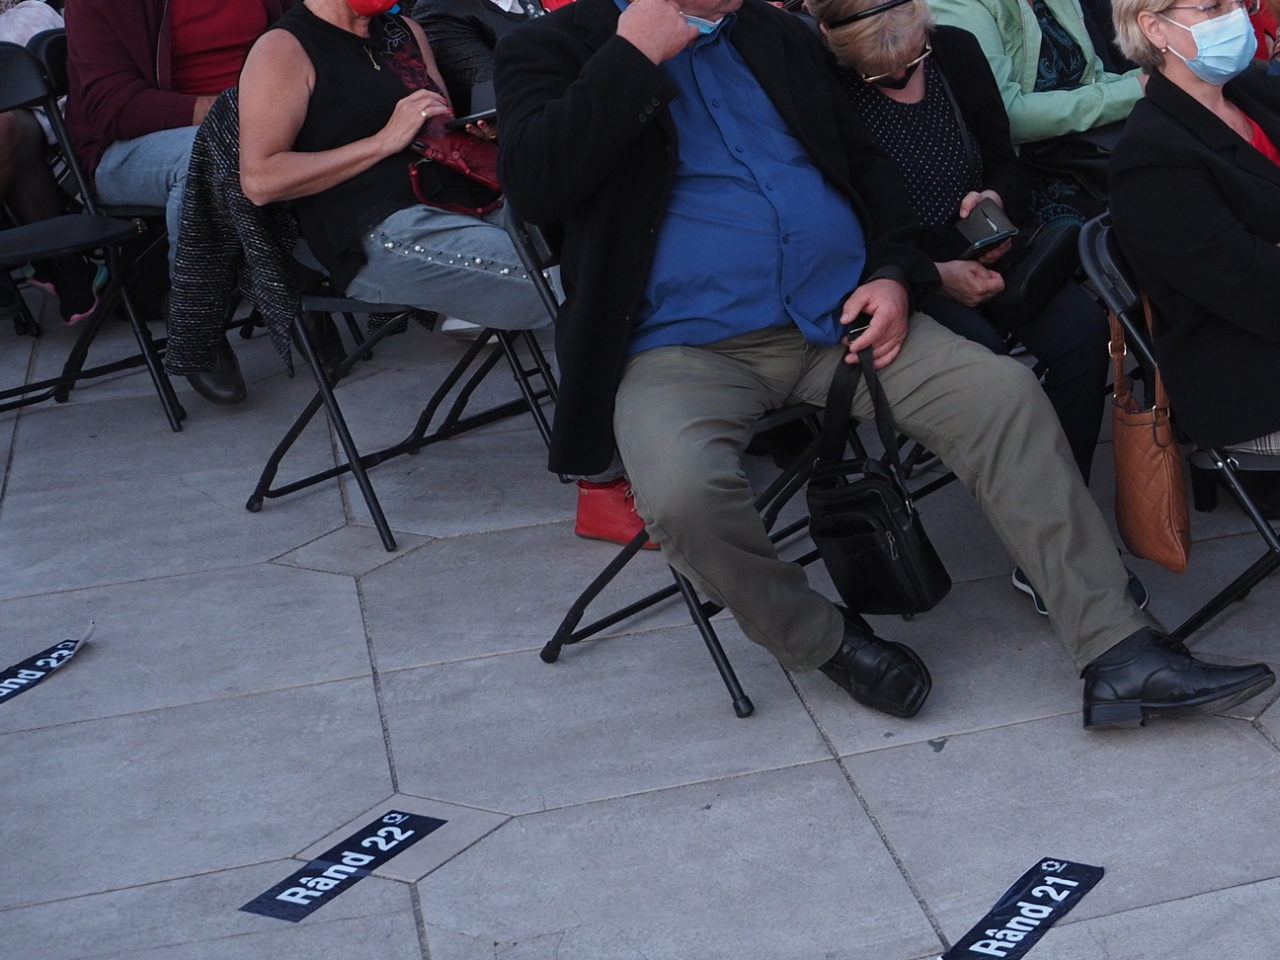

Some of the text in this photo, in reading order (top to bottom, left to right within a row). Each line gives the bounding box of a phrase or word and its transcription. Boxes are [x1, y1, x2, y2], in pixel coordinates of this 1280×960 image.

[0, 669, 47, 697] nd
[276, 826, 415, 905] Rând 22
[968, 876, 1080, 958] Rând 21
